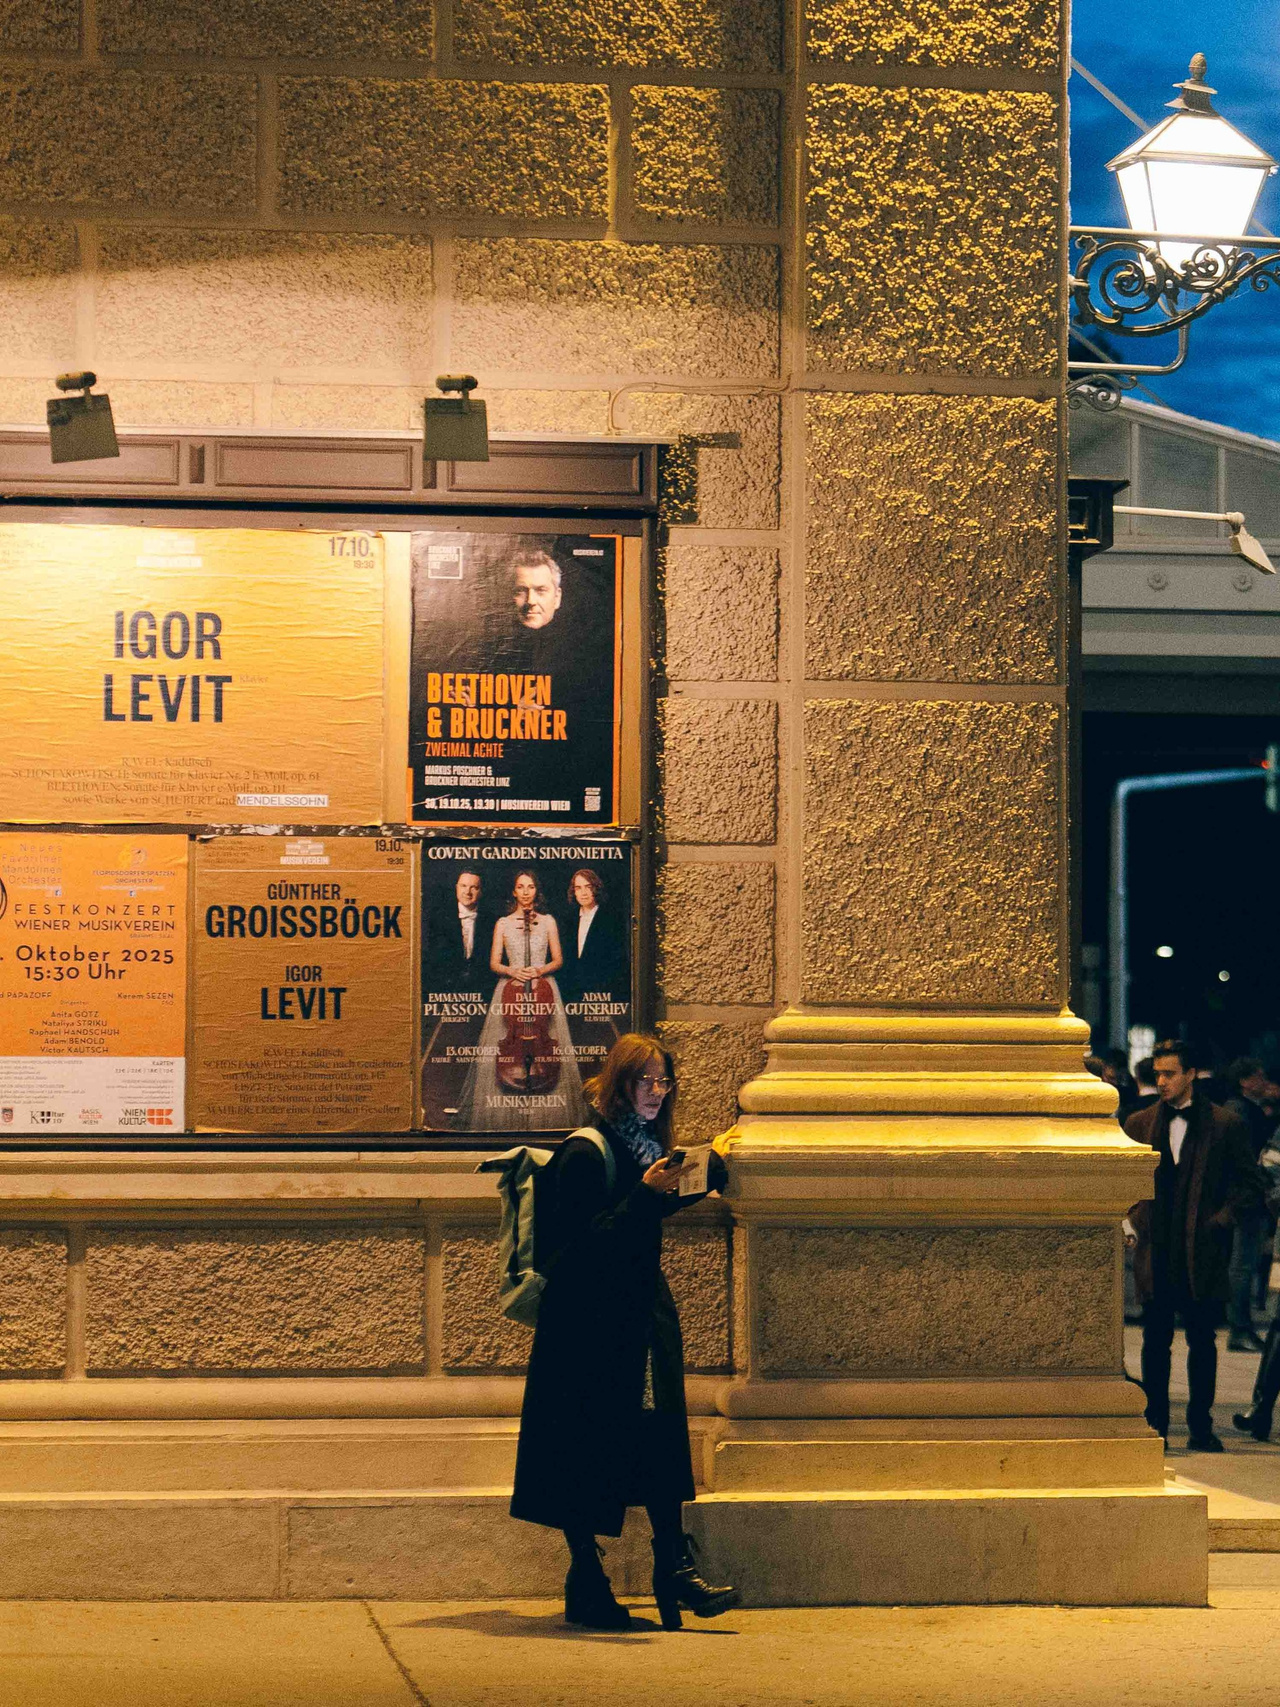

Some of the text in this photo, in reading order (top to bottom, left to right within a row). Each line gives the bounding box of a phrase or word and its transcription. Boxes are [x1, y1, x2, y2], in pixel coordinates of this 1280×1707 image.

[328, 536, 374, 557] 17.10.
[113, 610, 223, 661] IGOR
[427, 672, 551, 706] BEETHOVEN
[103, 673, 232, 723] LEVIT
[427, 706, 567, 741] & BRUCKNER
[425, 742, 504, 758] ZWEIMAL ACHTE
[132, 770, 167, 780] Sonate
[188, 770, 223, 780] Klavier
[244, 771, 250, 780] 2
[425, 765, 452, 775] MARKUS
[452, 765, 486, 776] POSCHNER
[123, 782, 157, 792] Sonate
[178, 782, 215, 792] Klavier
[424, 775, 510, 787] BRUCKNER ORCHESTER LINZ
[62, 795, 92, 804] sowie
[95, 795, 127, 805] Werke
[152, 795, 211, 805] SCHUBERT
[215, 795, 236, 806] und
[237, 796, 326, 806] MENDELSSOHN
[500, 799, 549, 811] MUSIKVEREIN
[550, 800, 571, 811] WIEN
[20, 843, 62, 852] Neues
[374, 839, 404, 852] 19.10.
[428, 846, 624, 860] COVENT GARDEN SINFONIETTA
[8, 875, 62, 884] Orchester
[267, 879, 341, 901] GÜNTHER
[14, 903, 176, 916] FESTKONZERT
[205, 898, 403, 939] GROISSBÖCK
[14, 919, 175, 932] WIENER MUSIKVEREIN
[15, 944, 174, 965] Oktober 2025
[24, 962, 126, 981] 15:30 Uhr
[285, 964, 322, 983] IGOR
[6, 991, 52, 999] PAPAZOFF
[146, 992, 174, 1000] SEZEN
[428, 993, 483, 1003] EMMANUEL
[515, 993, 538, 1003] DALI
[582, 992, 611, 1002] ADAM
[260, 986, 347, 1020] LEVIT
[565, 1003, 629, 1015] GUTSERIEV
[50, 1010, 73, 1018] Anita
[424, 1003, 487, 1016] PLASSON
[491, 1003, 563, 1016] GUTSERIEVA
[76, 1019, 108, 1027] STRIKU
[441, 1016, 470, 1024] DIRIGENT
[28, 1028, 120, 1037] Raphael HANDSCHUH
[44, 1037, 105, 1045] Adam BENOLD
[67, 1046, 109, 1054] KAUTSCH
[486, 1095, 567, 1108] MUSIKVEREIN
[121, 1108, 146, 1117] WIEN
[118, 1117, 147, 1126] KULTUR
